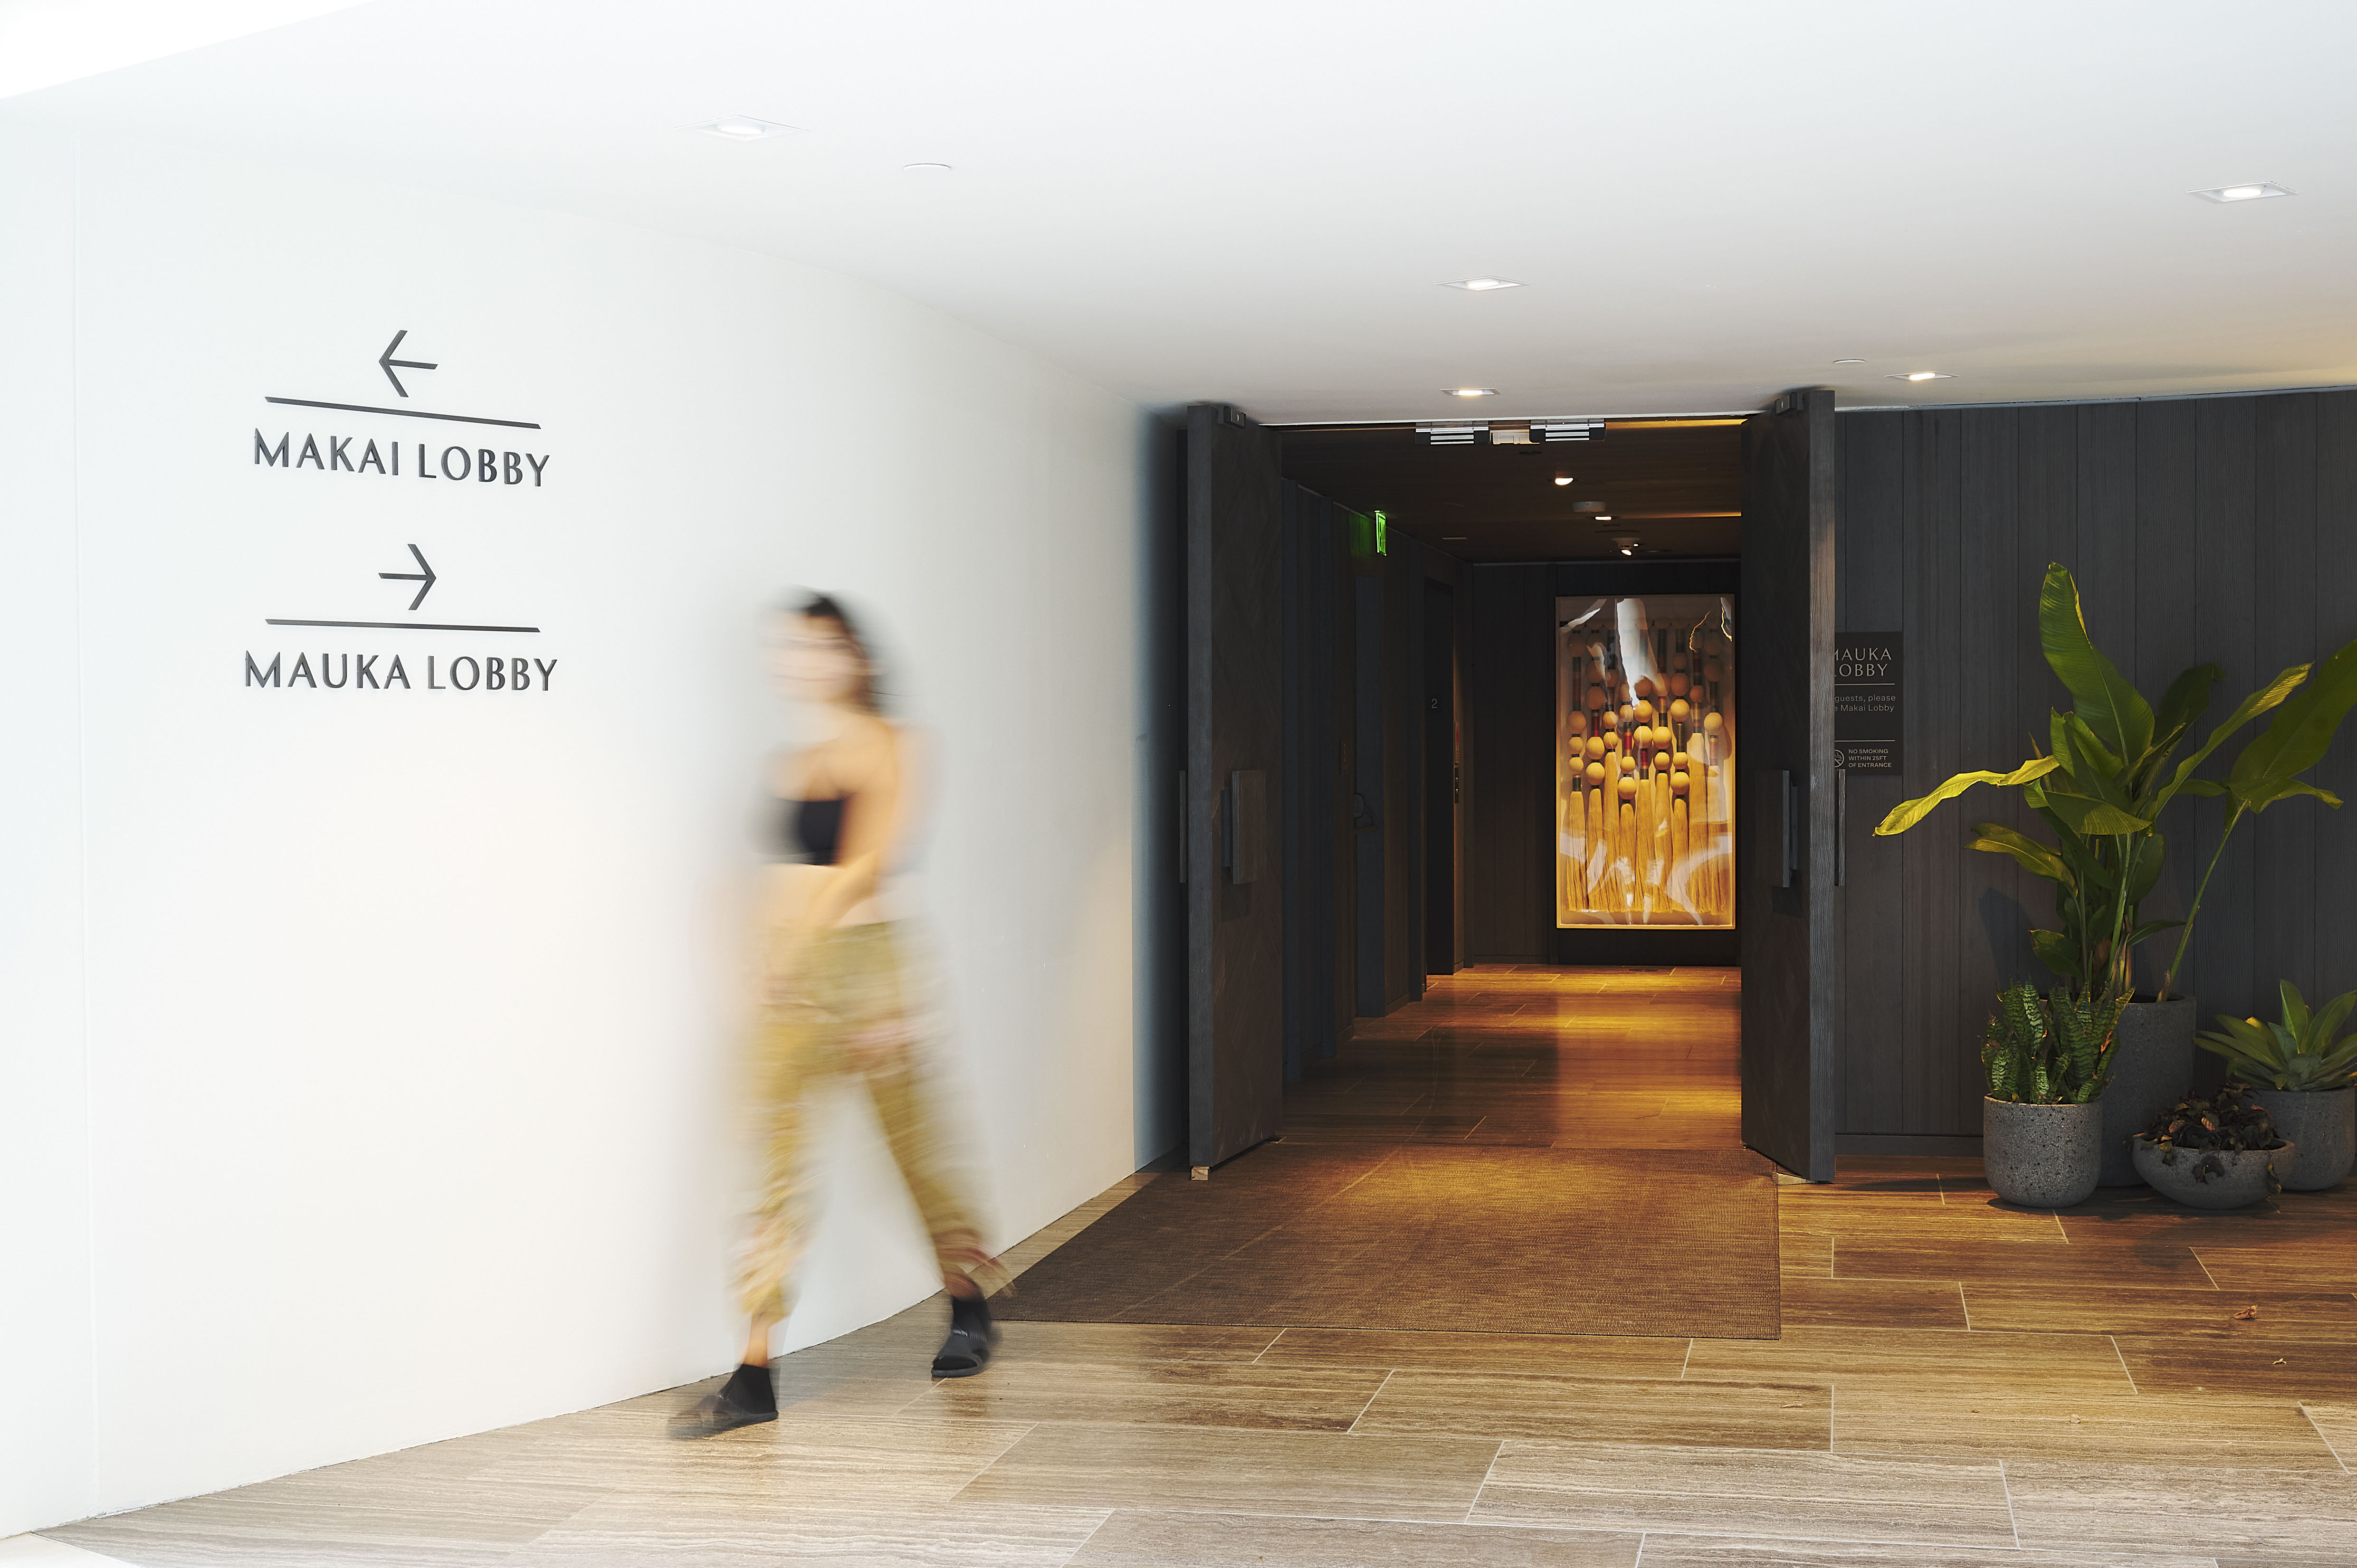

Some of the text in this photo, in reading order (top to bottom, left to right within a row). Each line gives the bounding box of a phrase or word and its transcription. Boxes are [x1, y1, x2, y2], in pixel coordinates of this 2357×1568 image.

[254, 428, 550, 487] MAKAI LOBBY
[245, 650, 558, 691] MAUKA LOBBY
[1834, 664, 1888, 677] OBBY
[1431, 698, 1438, 709] 2
[1868, 694, 1896, 703] please
[1868, 704, 1894, 713] Lobby
